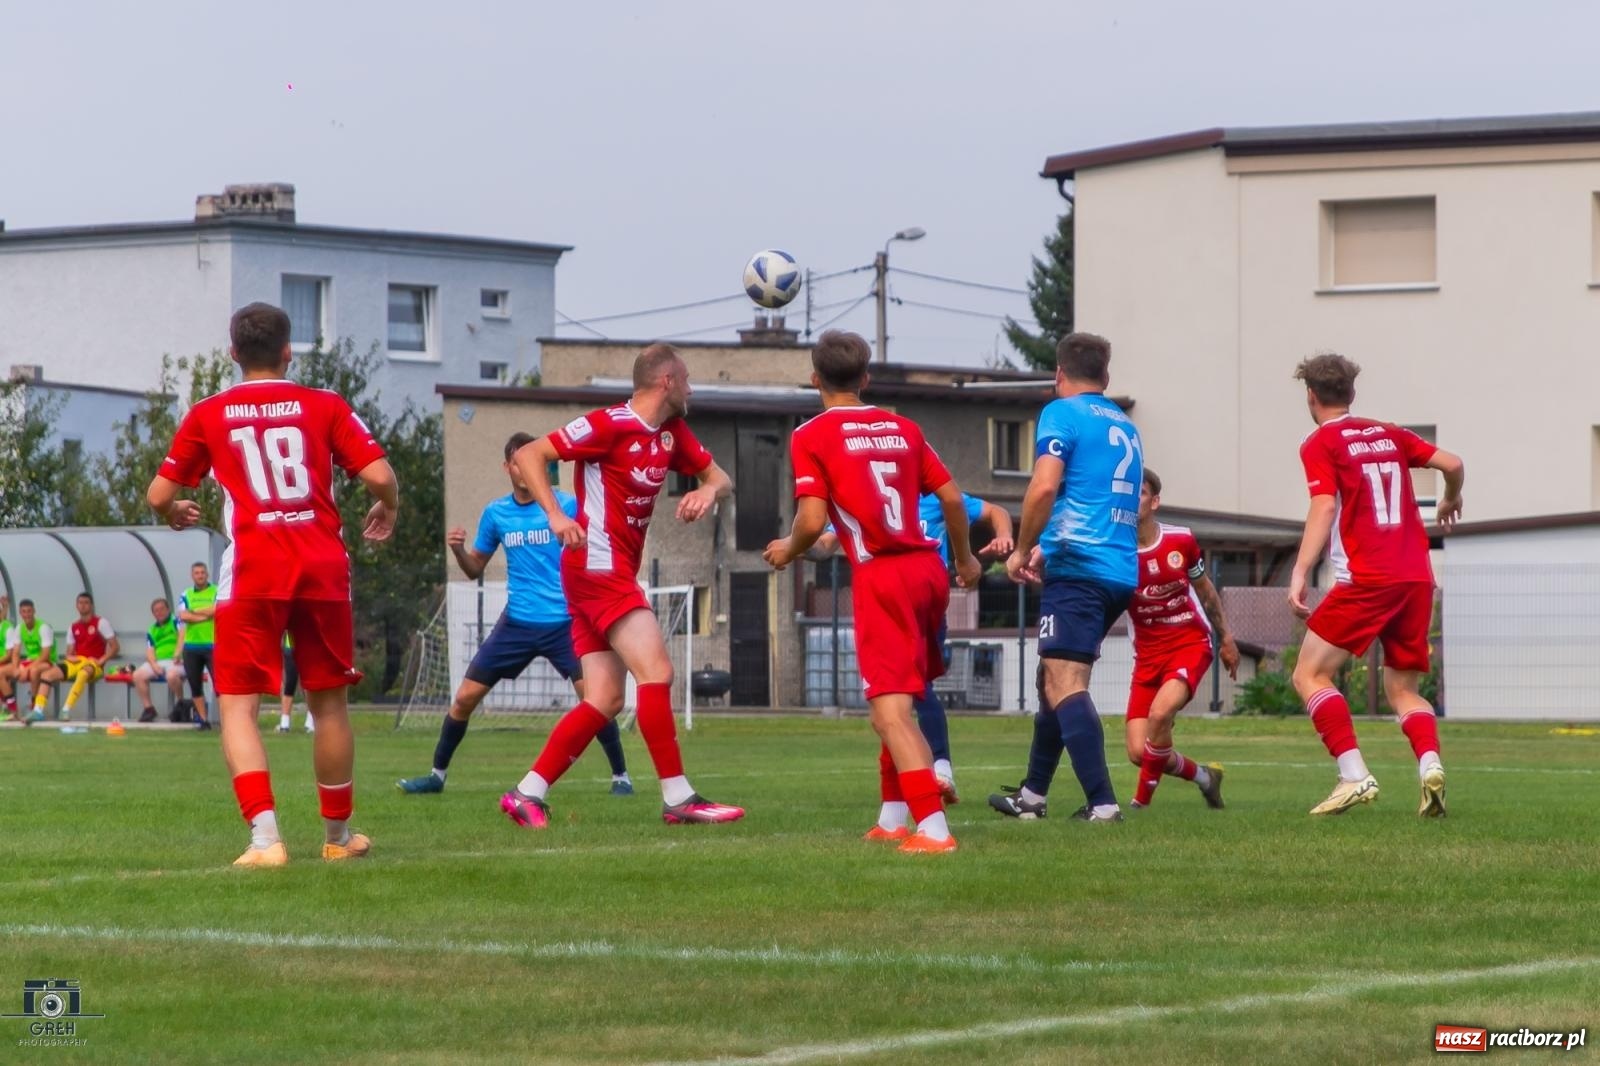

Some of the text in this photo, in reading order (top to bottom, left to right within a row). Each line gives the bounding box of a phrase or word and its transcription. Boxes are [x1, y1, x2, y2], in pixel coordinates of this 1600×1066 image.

[225, 401, 302, 418] UNIA TURZA
[845, 435, 909, 450] UNIA TURZA
[1048, 438, 1064, 456] C
[230, 426, 309, 500] 18
[869, 460, 903, 530] 5
[1361, 461, 1401, 525] 17
[1039, 614, 1054, 638] 21
